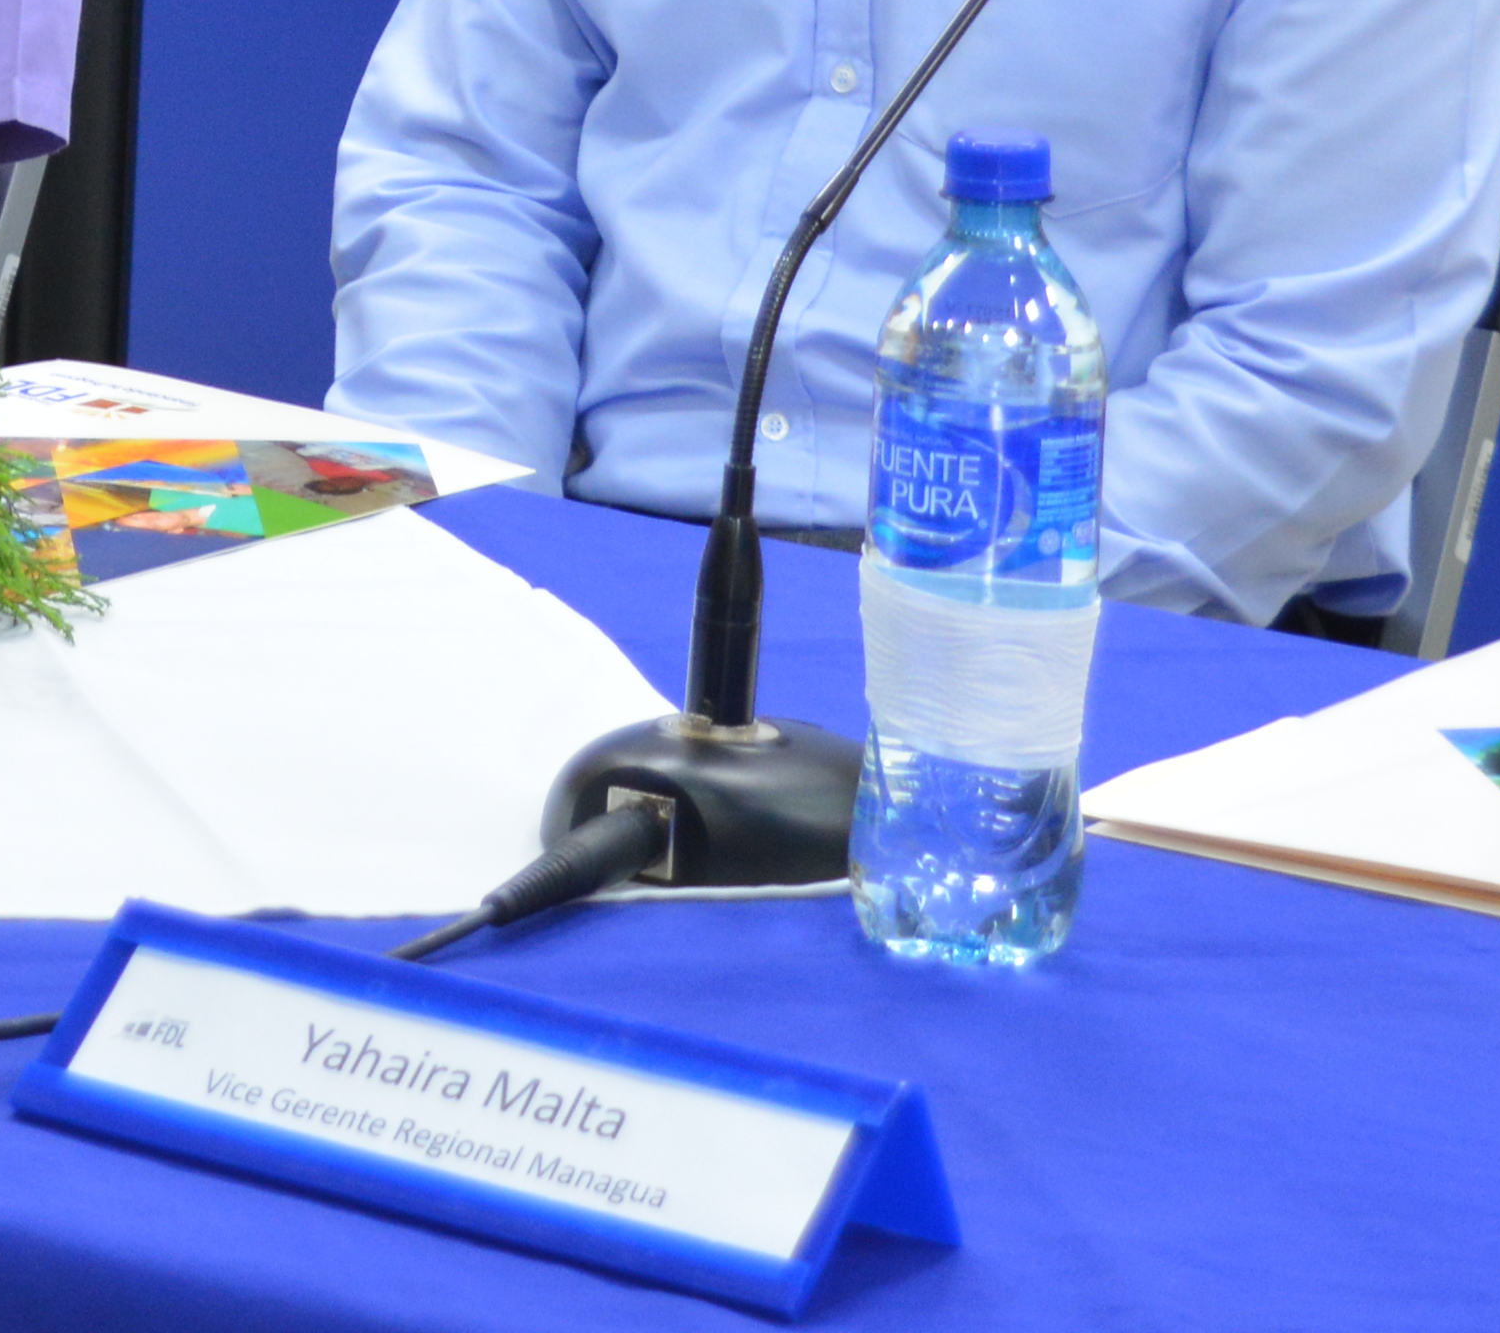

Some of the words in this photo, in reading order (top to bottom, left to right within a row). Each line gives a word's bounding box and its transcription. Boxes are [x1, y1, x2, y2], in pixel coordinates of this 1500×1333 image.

[873, 436, 981, 486] FUENTE
[891, 478, 979, 520] PURA
[150, 1017, 190, 1052] FDL
[297, 1021, 475, 1106] Yahaira
[480, 1065, 629, 1143] Malta
[203, 1069, 266, 1107] Vice
[268, 1085, 389, 1142] Gerente
[390, 1114, 525, 1175] Regional
[523, 1150, 671, 1215] Managua
